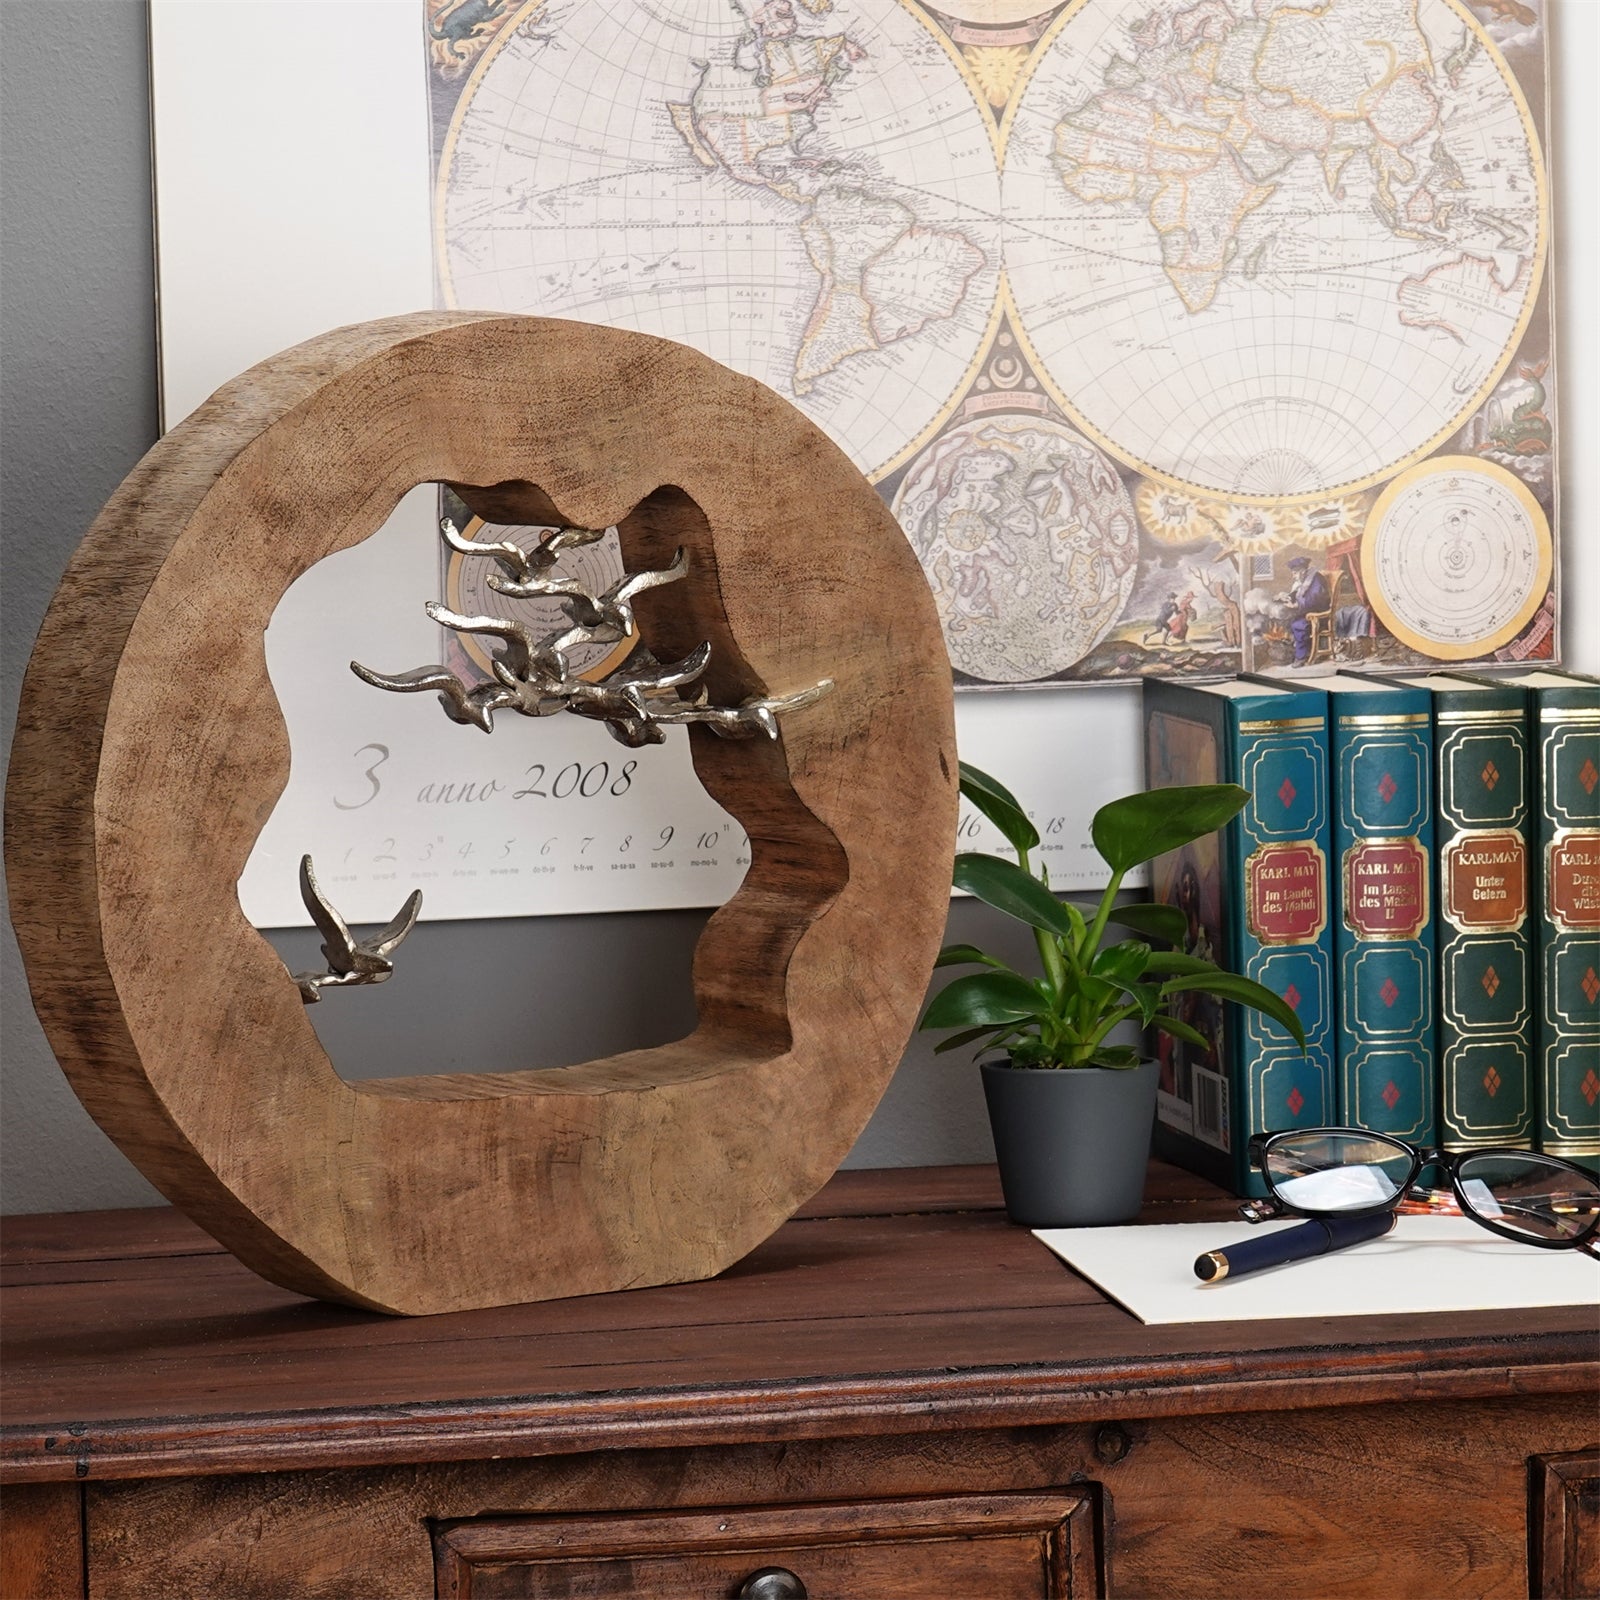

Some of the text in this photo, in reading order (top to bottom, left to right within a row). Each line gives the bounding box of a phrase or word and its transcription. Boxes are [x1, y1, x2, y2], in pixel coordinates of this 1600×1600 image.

[607, 187, 668, 198] MAR
[678, 209, 717, 217] DEL
[736, 290, 767, 298] MARE
[333, 743, 637, 810] 3 anno 2008
[957, 814, 983, 838] 16
[1045, 816, 1065, 834] 18
[373, 838, 397, 862] 2
[418, 843, 434, 861] 3
[458, 842, 476, 860] 4
[500, 838, 516, 859] 5
[540, 837, 558, 856] 6
[580, 837, 595, 854] 7
[619, 835, 633, 852] 8
[652, 826, 675, 851] 9
[697, 831, 719, 849] 10
[1561, 854, 1591, 865] KARL
[1260, 866, 1314, 879] KARL MAY
[1358, 864, 1389, 875] KARL
[1476, 876, 1504, 887] Unter
[1266, 887, 1313, 901] Im Lande
[1364, 885, 1378, 895] Im
[1263, 902, 1282, 913] des
[1359, 896, 1380, 908] des
